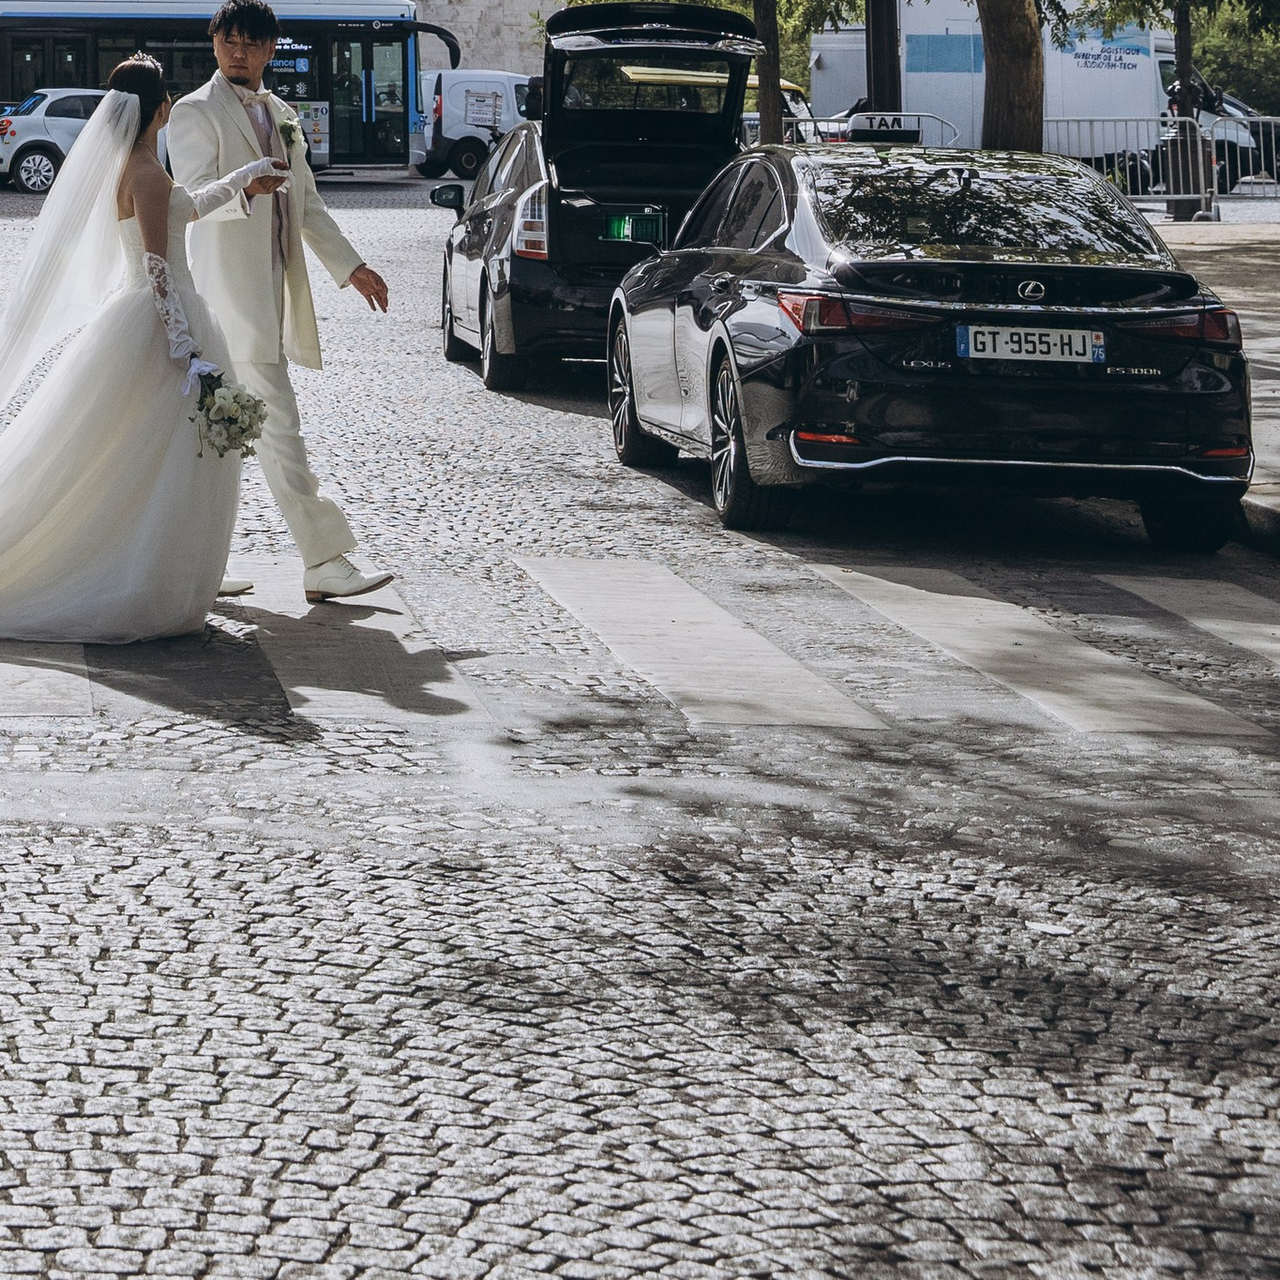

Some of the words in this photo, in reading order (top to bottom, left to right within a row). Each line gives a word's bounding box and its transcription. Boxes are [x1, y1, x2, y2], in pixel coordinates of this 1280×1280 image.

[973, 330, 1088, 357] GT-955-HJ
[1092, 347, 1105, 359] 75
[902, 360, 951, 369] LEXUS
